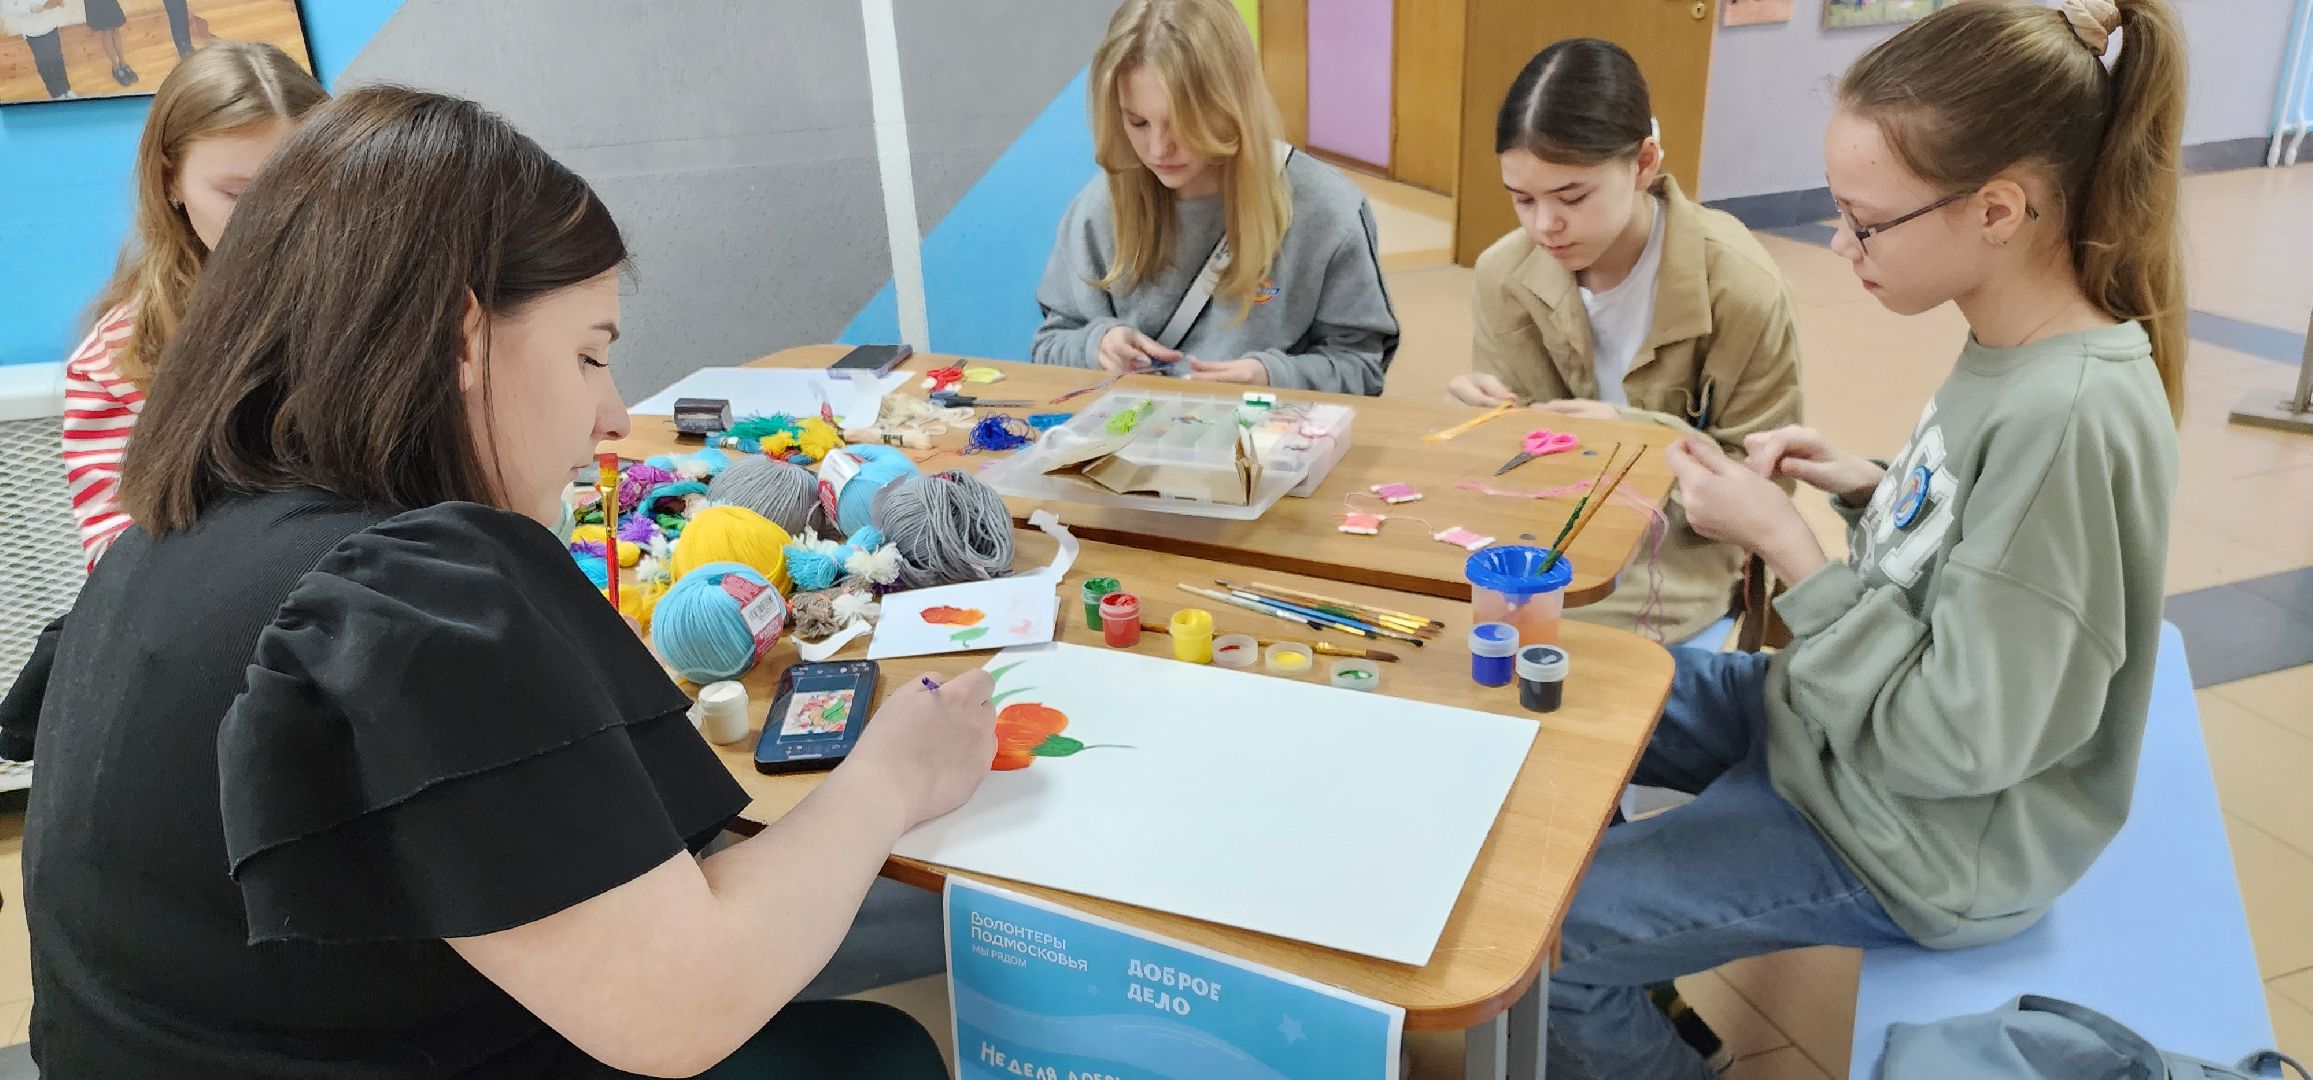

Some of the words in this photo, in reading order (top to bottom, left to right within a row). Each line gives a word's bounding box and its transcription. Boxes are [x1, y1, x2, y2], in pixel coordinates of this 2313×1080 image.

[971, 911, 1066, 950] ВОЛОНТЕРЫ
[971, 926, 1088, 972] ПОДМОСКОВЬЯ
[972, 944, 989, 956] МЫ
[991, 949, 1027, 968] РЯДОМ
[1127, 959, 1221, 1001] ДОБРОЕ
[1127, 983, 1190, 1015] ДЕЛО
